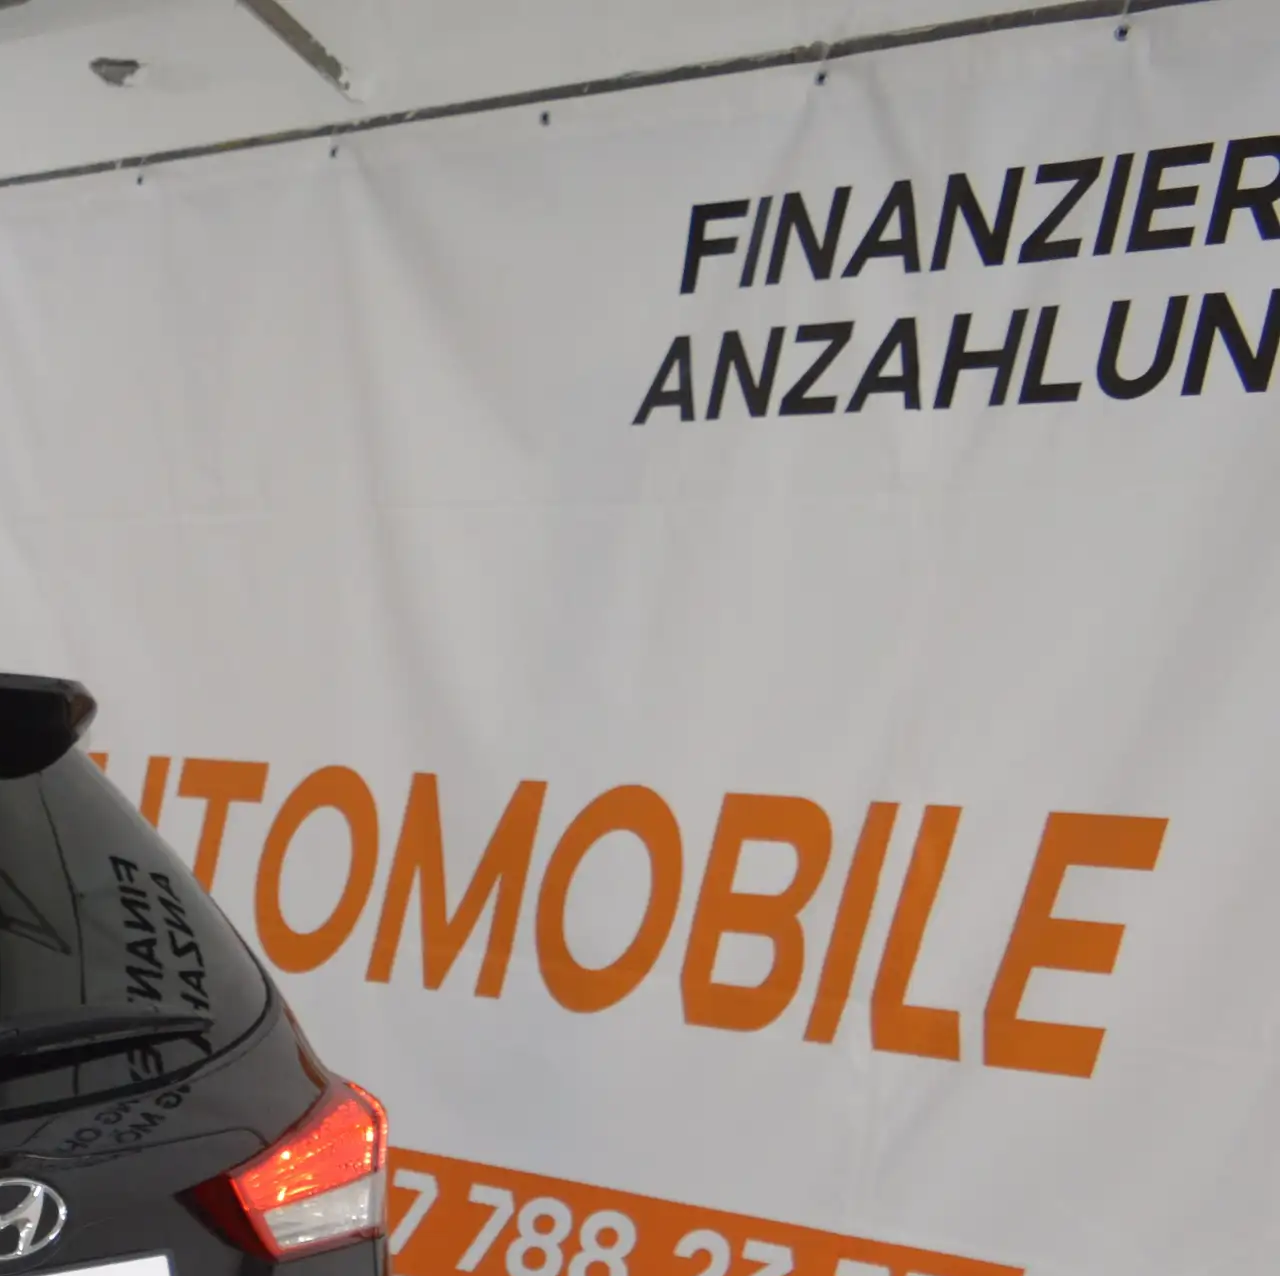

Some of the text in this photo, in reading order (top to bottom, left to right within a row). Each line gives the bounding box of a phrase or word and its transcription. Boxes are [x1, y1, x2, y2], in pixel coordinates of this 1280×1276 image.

[679, 134, 1280, 295] FINANZIER
[631, 287, 1280, 425] ANZAHLUN
[88, 752, 1169, 1078] TOMOBILE
